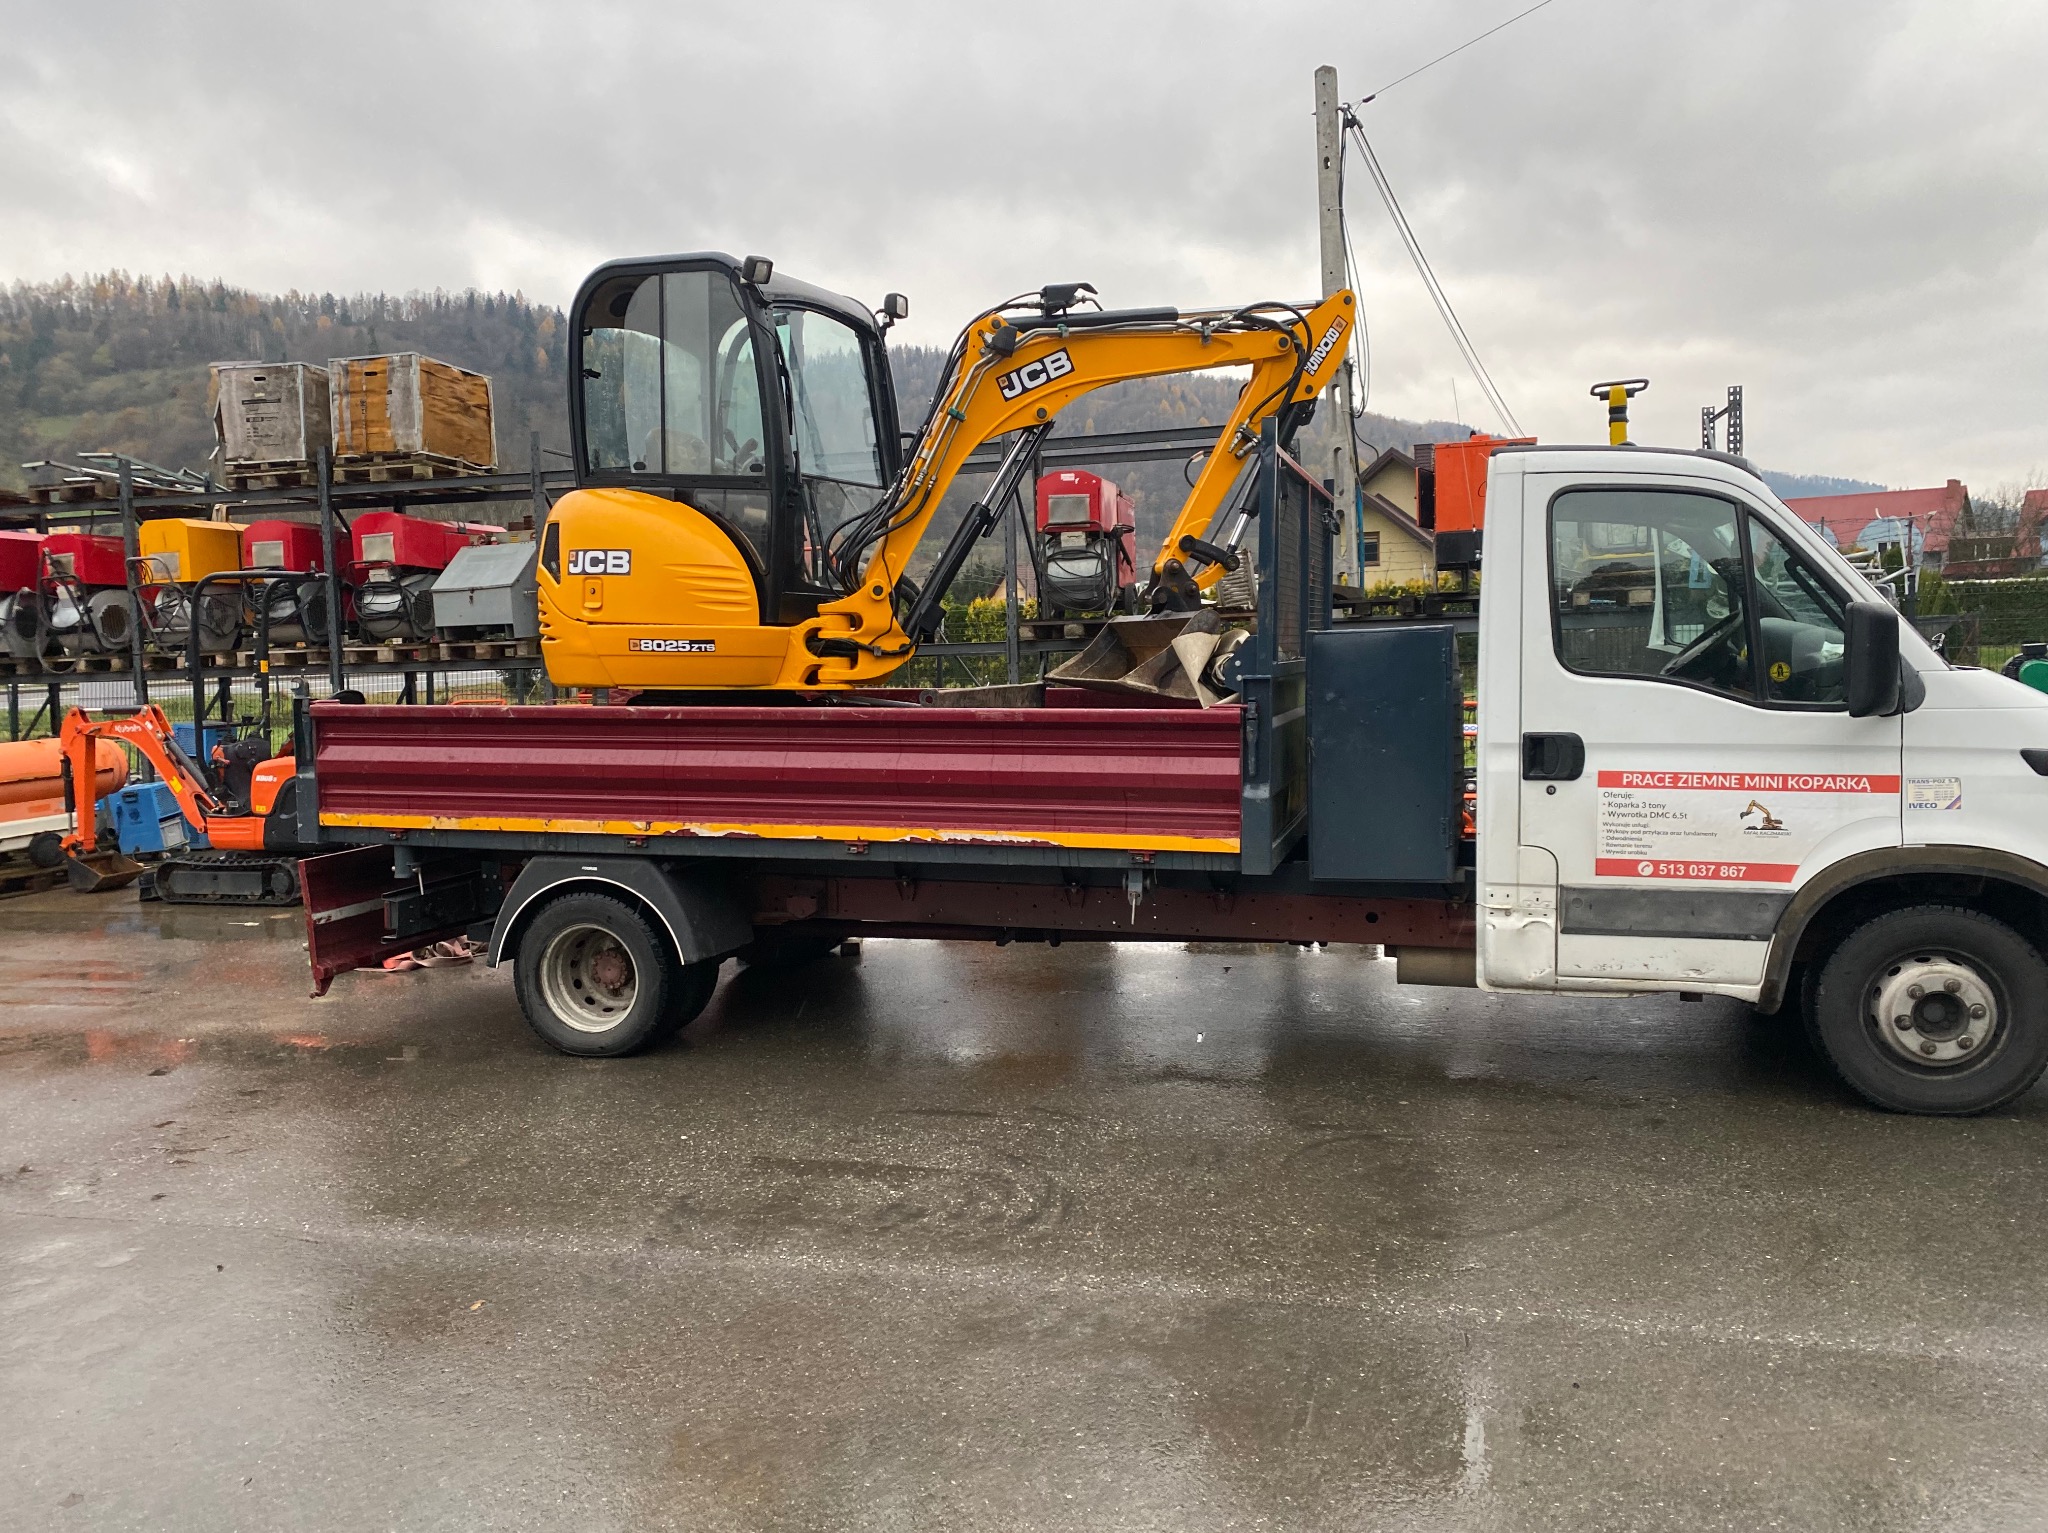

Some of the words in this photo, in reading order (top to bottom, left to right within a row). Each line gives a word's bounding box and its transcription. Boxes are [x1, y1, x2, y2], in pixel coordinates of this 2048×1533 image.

[1002, 350, 1072, 399] JCB
[569, 550, 630, 574] JCB
[1622, 772, 1674, 787] PRACE
[1677, 773, 1740, 788] ZIEMNE
[1744, 775, 1783, 789] MINI
[1787, 776, 1871, 792] KOPARKĄ
[1603, 791, 1635, 799] Oferuję:
[1607, 801, 1640, 811] Koparka
[1641, 801, 1647, 809] 3
[1648, 802, 1667, 810] tony
[1607, 810, 1648, 819] Wywrotka
[1649, 811, 1671, 819] DMC
[1658, 863, 1685, 876] 513
[1689, 864, 1716, 877] 037
[1719, 865, 1747, 878] 867
